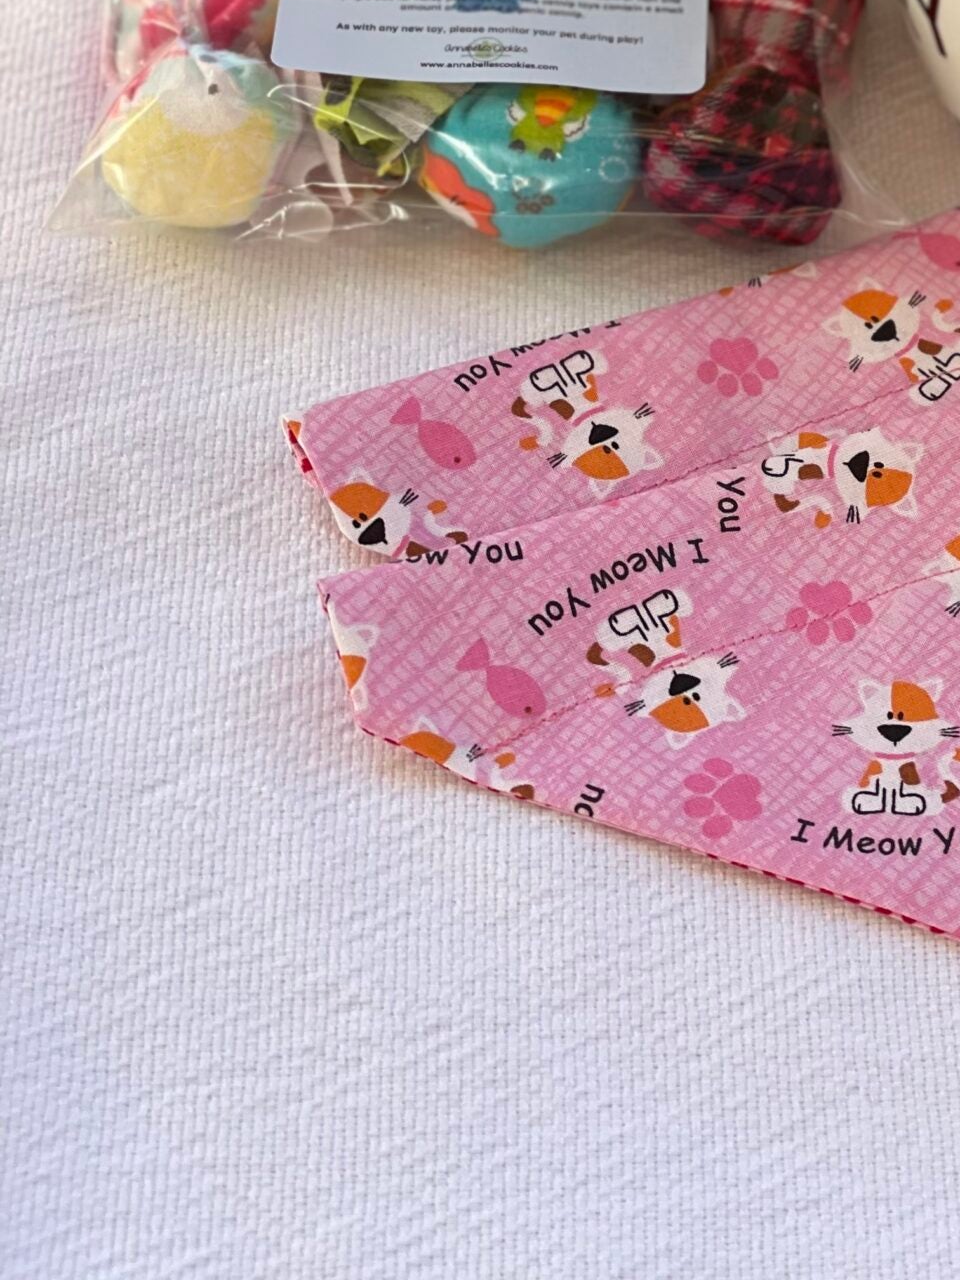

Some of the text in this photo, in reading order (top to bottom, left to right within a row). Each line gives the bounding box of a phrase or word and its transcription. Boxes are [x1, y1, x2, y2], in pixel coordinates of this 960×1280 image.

[335, 22, 350, 32] As
[352, 22, 377, 32] with
[378, 24, 399, 35] any
[400, 26, 424, 34] new
[426, 25, 447, 36] toy,
[449, 26, 486, 37] please
[487, 25, 530, 36] monitor
[532, 29, 557, 39] your
[559, 31, 578, 41] pet
[579, 31, 615, 44] during
[420, 60, 559, 72] www.annabellescookies.com
[453, 355, 513, 392] You
[716, 476, 746, 533] You
[459, 539, 524, 565] You
[527, 538, 710, 636] I Meow You
[790, 818, 816, 843] I
[822, 826, 923, 856] Meow
